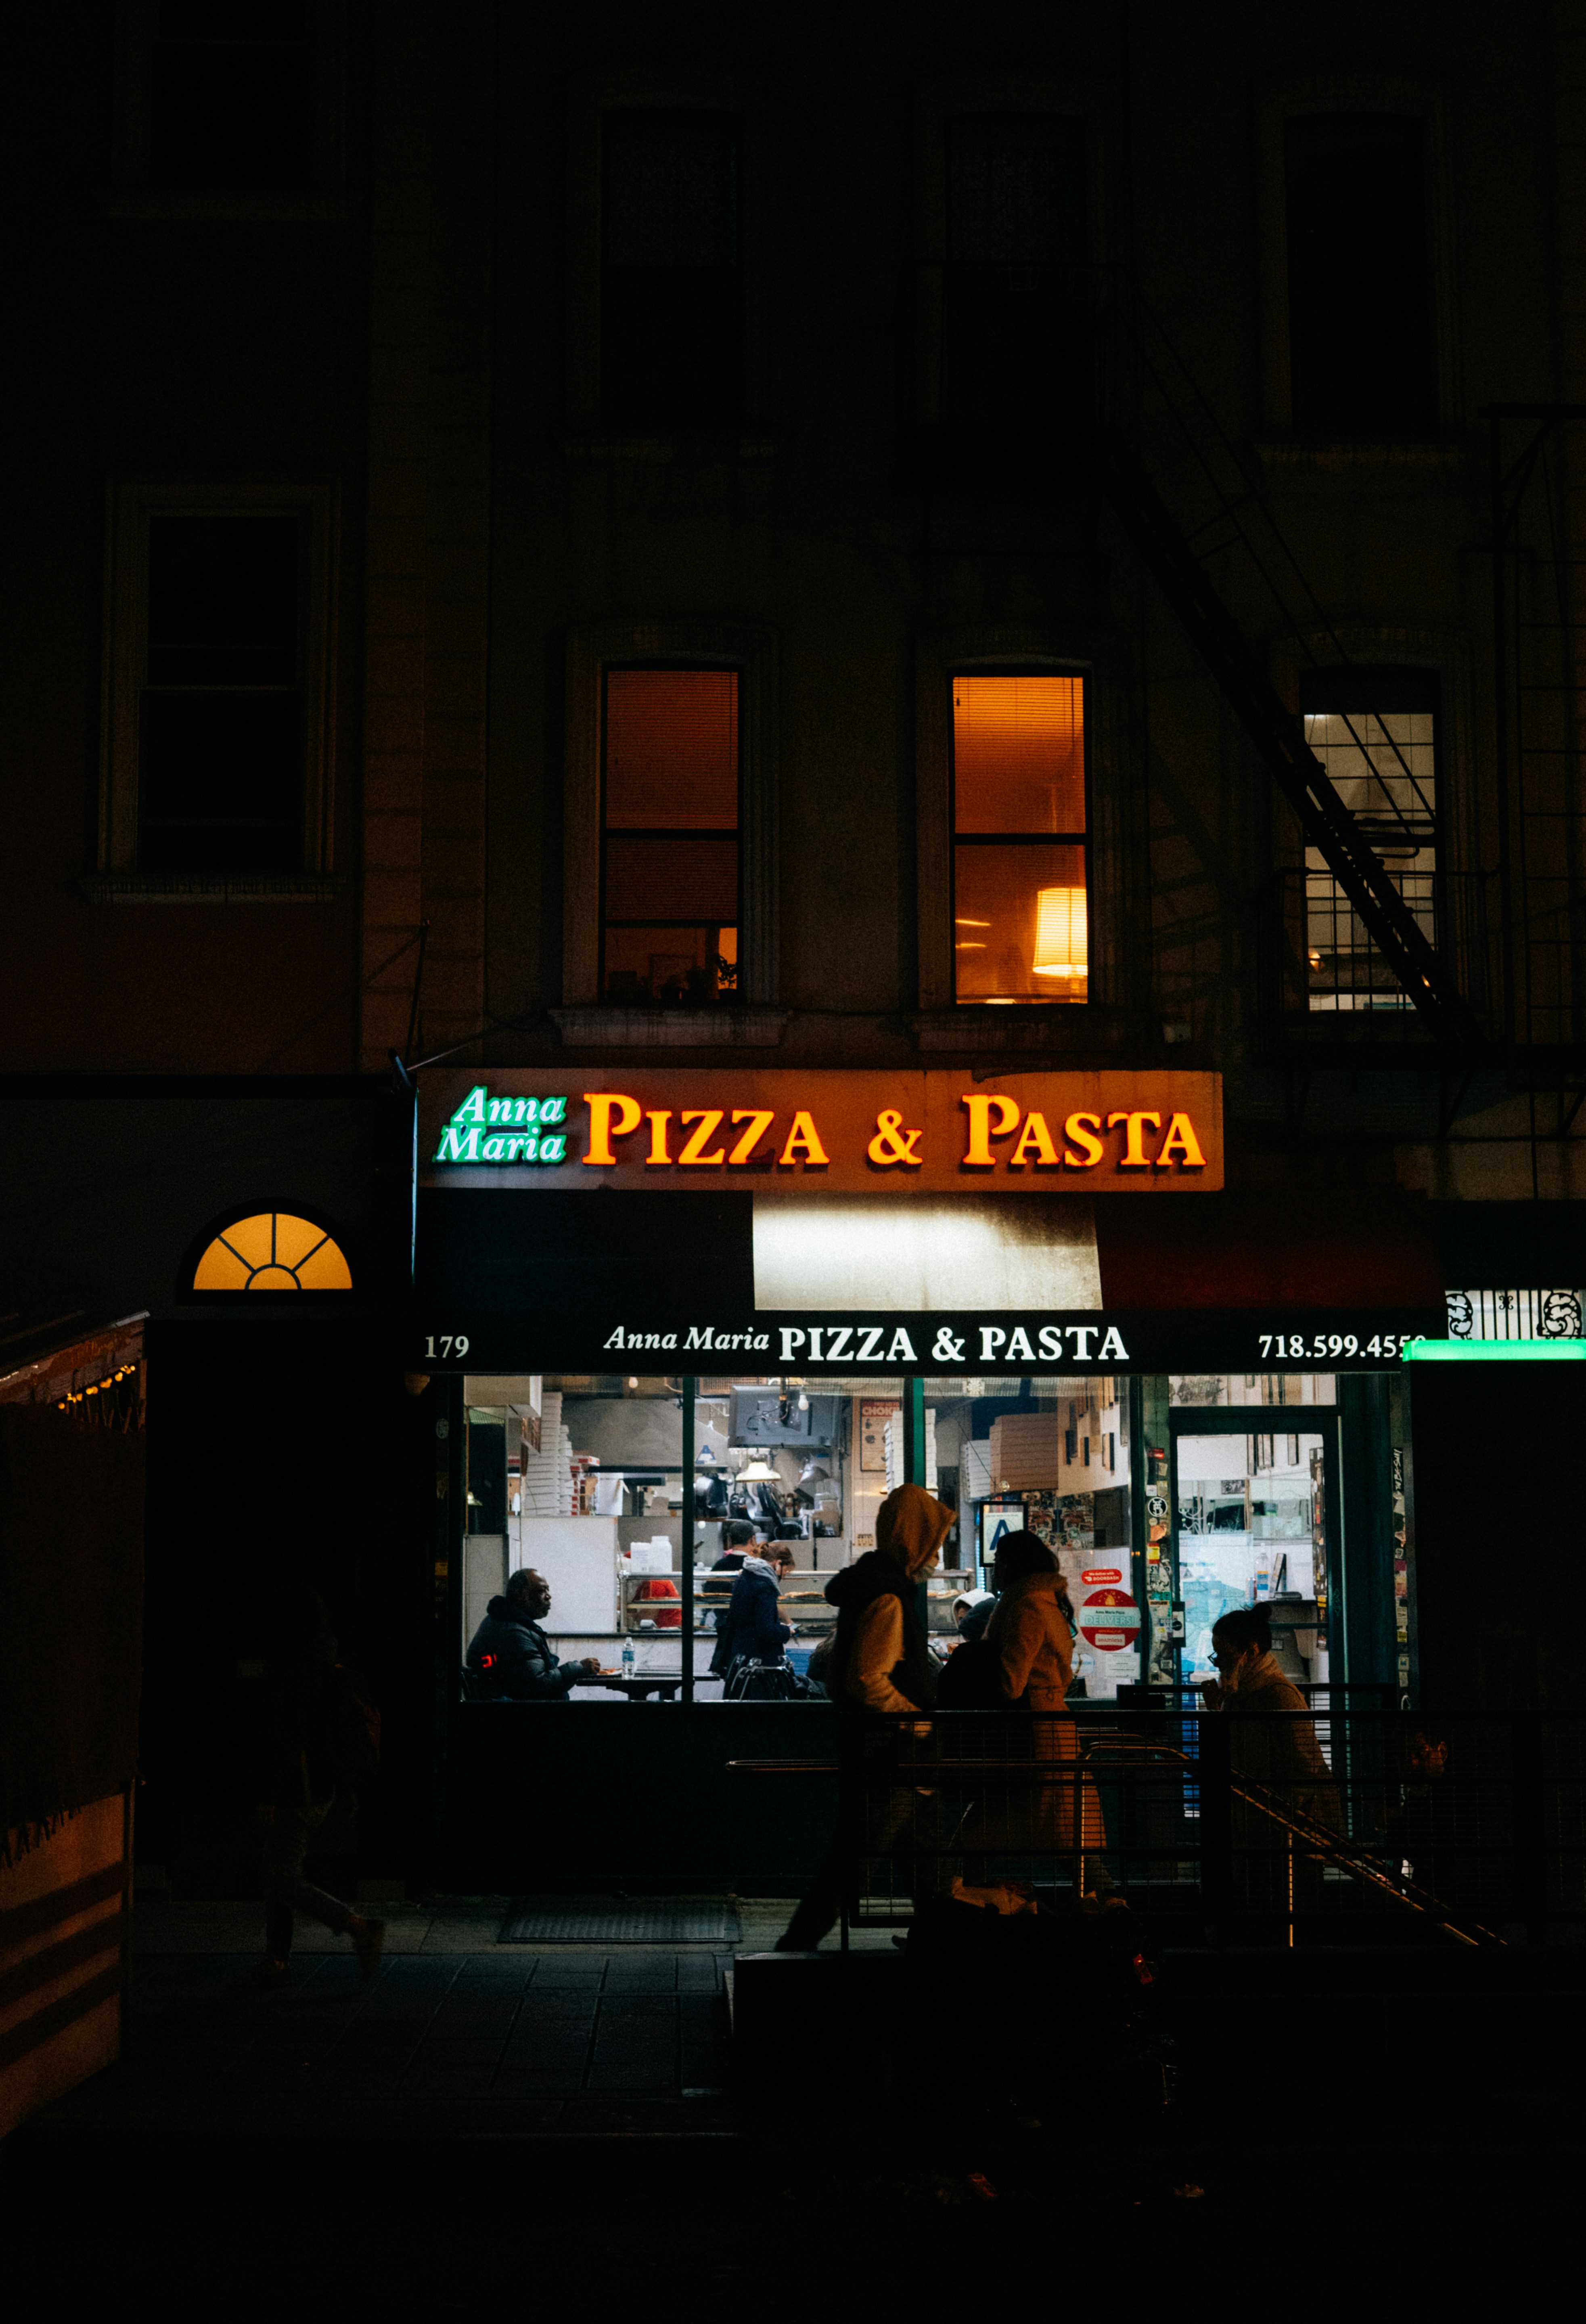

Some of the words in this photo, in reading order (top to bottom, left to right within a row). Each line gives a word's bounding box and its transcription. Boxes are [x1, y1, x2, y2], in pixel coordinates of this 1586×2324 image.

[452, 1088, 566, 1122] Anna
[436, 1126, 566, 1160] Maria
[582, 1093, 830, 1165] PIZZA
[867, 1109, 923, 1165] &
[962, 1094, 1207, 1166] PASTA
[425, 1336, 469, 1358] 179
[603, 1326, 677, 1350] Anna
[682, 1327, 770, 1350] Maria
[778, 1327, 918, 1361] PIZZA
[931, 1327, 966, 1361] &
[979, 1326, 1130, 1361] PASTA
[989, 1519, 1010, 1551] A
[1084, 1615, 1135, 1626] DELIVERS!
